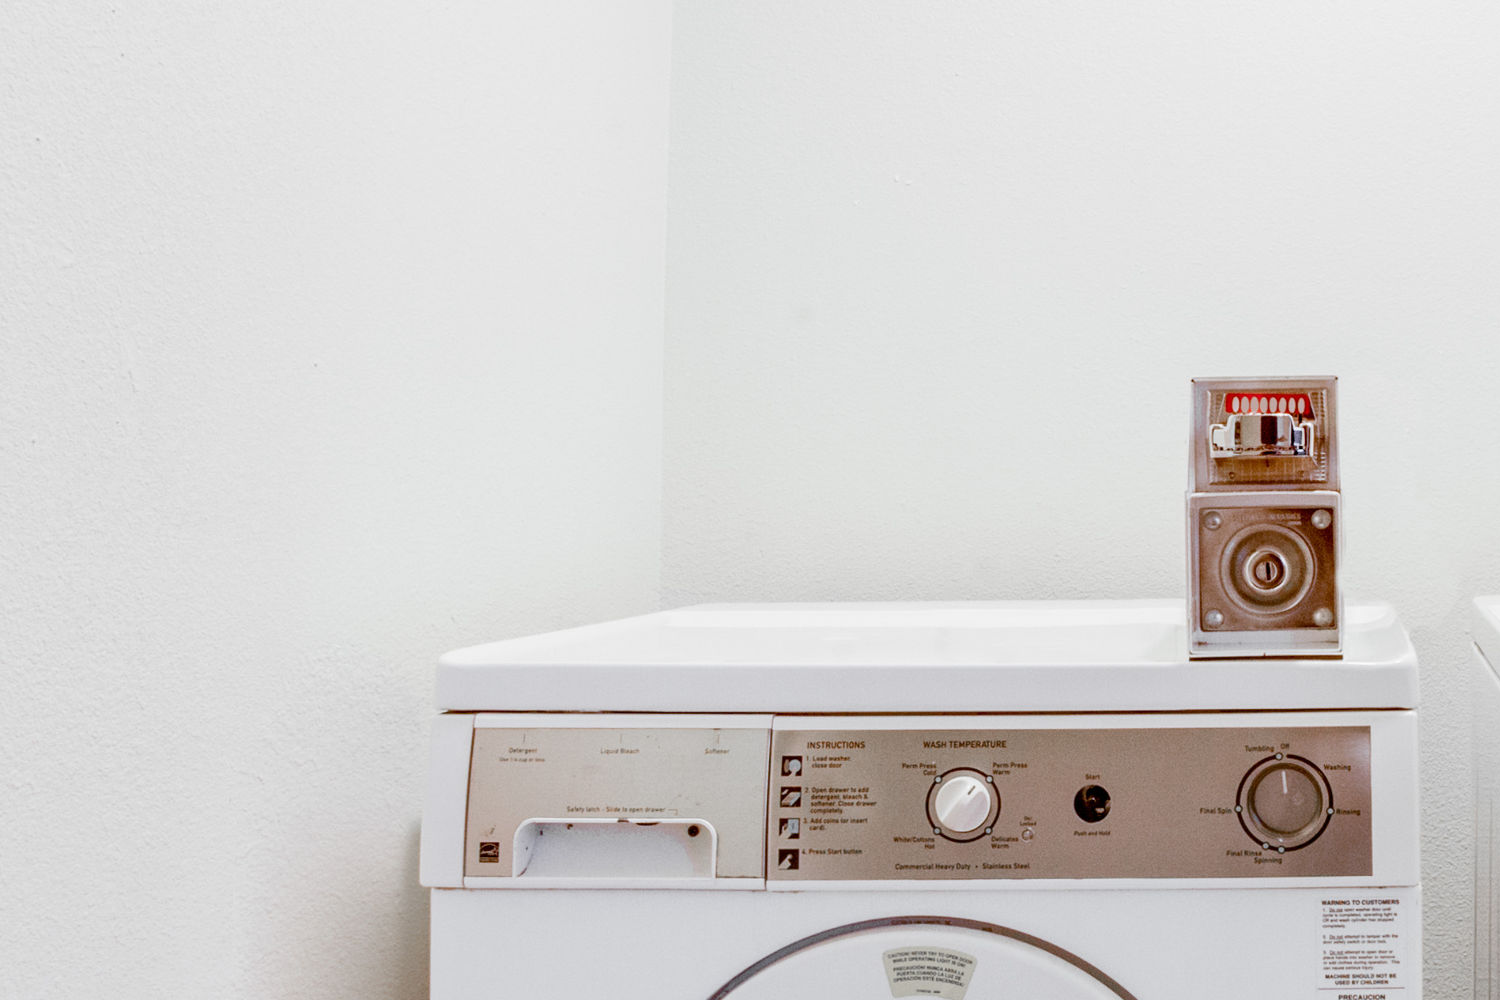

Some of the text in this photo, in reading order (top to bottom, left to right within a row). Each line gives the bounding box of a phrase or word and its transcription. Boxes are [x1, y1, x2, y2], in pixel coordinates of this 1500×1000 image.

[807, 741, 865, 749] INSTRUCTIONS
[924, 740, 1007, 749] WASH TEMPERATURE
[567, 806, 585, 814] Safety
[956, 863, 971, 871] Duty
